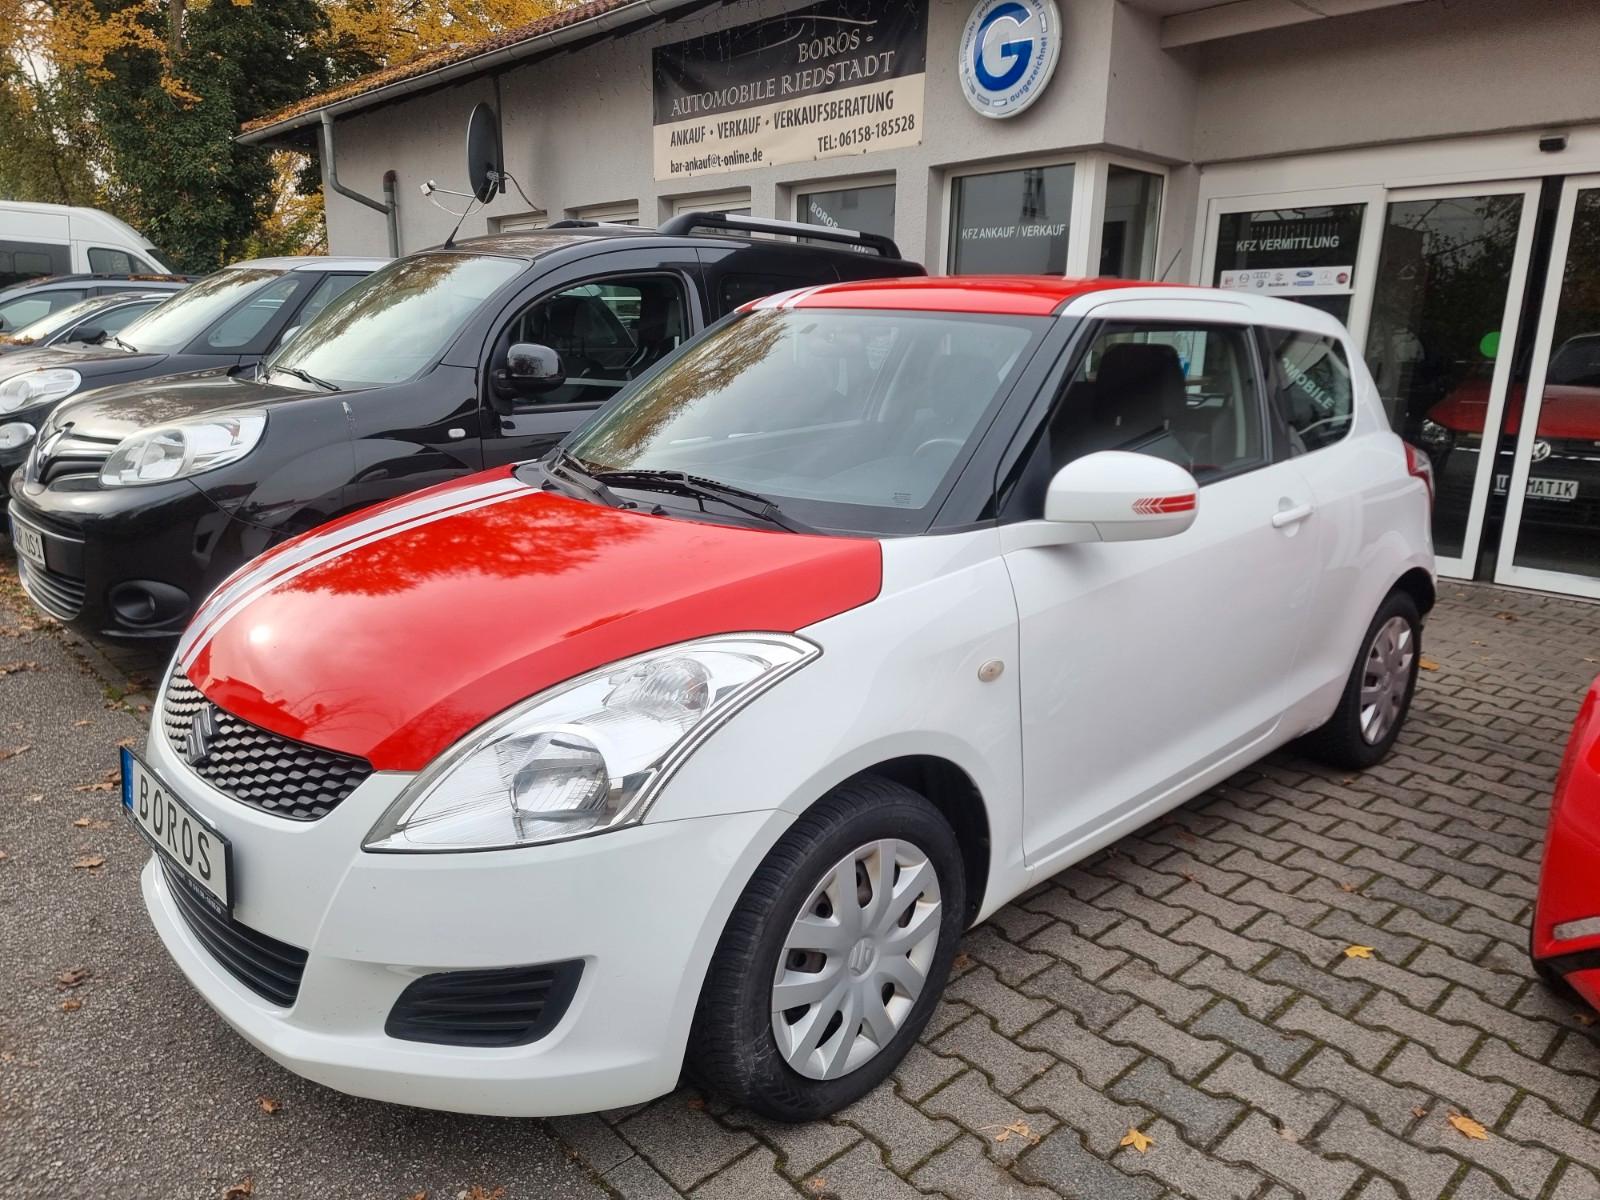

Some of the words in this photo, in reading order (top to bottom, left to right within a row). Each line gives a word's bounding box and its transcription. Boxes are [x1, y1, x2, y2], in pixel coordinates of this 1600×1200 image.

[798, 28, 861, 64] BOROS
[973, 2, 1035, 92] G
[671, 78, 775, 117] AUTOMOBILE
[781, 51, 895, 94] RIEDSTADT
[1010, 37, 1048, 102] ausgezeichnet
[670, 125, 706, 148] ANKAUF
[717, 115, 761, 140] VERKAUF
[774, 90, 894, 129] VERKAUFSBERATUNG
[818, 133, 838, 153] TEL:
[839, 114, 915, 147] 06158-185528
[670, 148, 763, 174] bar-ankauf@t-online.de
[809, 201, 839, 230] BOROS
[962, 228, 979, 239] KFZ
[979, 226, 1015, 239] ANKAUF
[1022, 223, 1066, 238] VERKAUF
[1236, 239, 1257, 252] KFZ
[1260, 235, 1340, 251] VERMITTLUNG
[140, 774, 211, 881] BOROS
